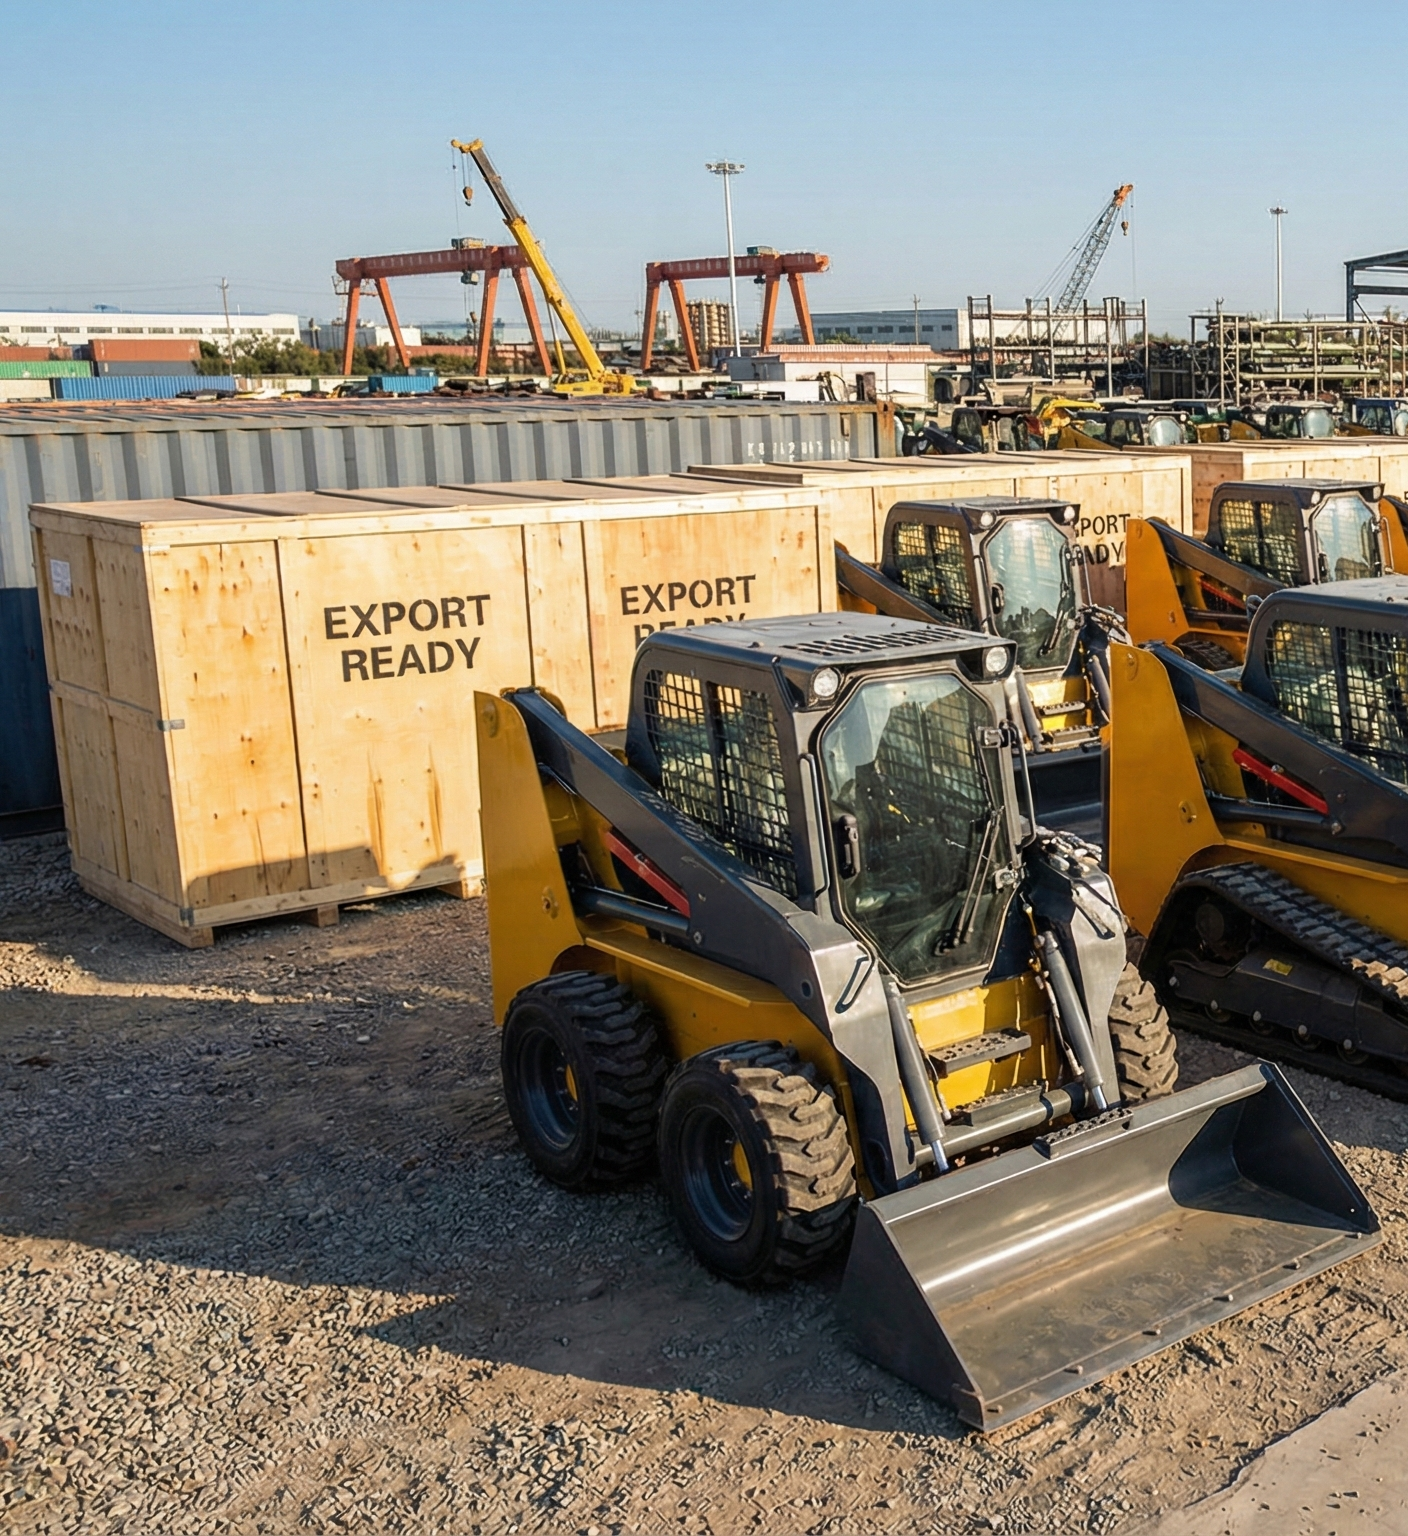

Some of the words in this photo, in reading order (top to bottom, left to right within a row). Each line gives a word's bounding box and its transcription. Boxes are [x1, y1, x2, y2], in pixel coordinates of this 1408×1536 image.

[1076, 513, 1131, 537] PORT
[323, 594, 491, 640] EXPORT
[620, 574, 756, 616] EXPORT
[341, 637, 481, 683] READY
